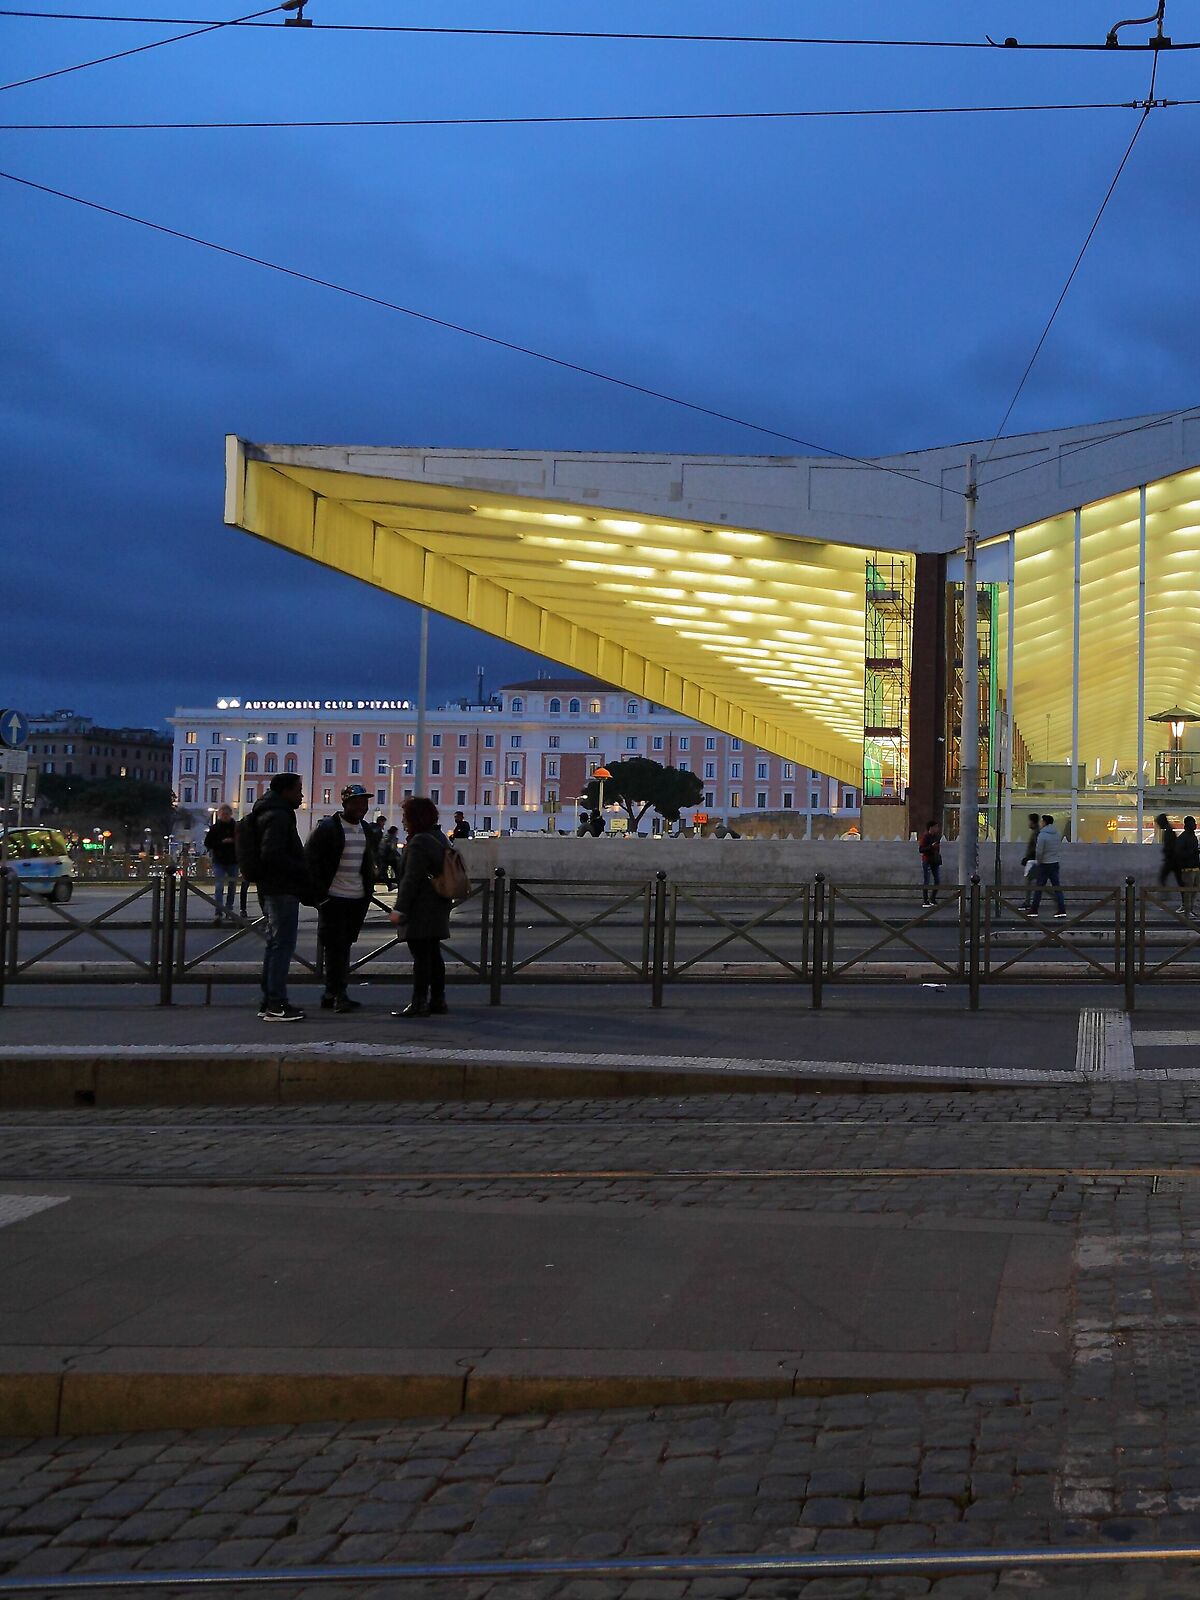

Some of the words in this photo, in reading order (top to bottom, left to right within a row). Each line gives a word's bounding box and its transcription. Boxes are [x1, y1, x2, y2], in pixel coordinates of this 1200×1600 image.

[245, 700, 321, 710] AUTOMOBILE
[324, 700, 353, 710] CLUB
[357, 700, 410, 709] D'ITALIA
